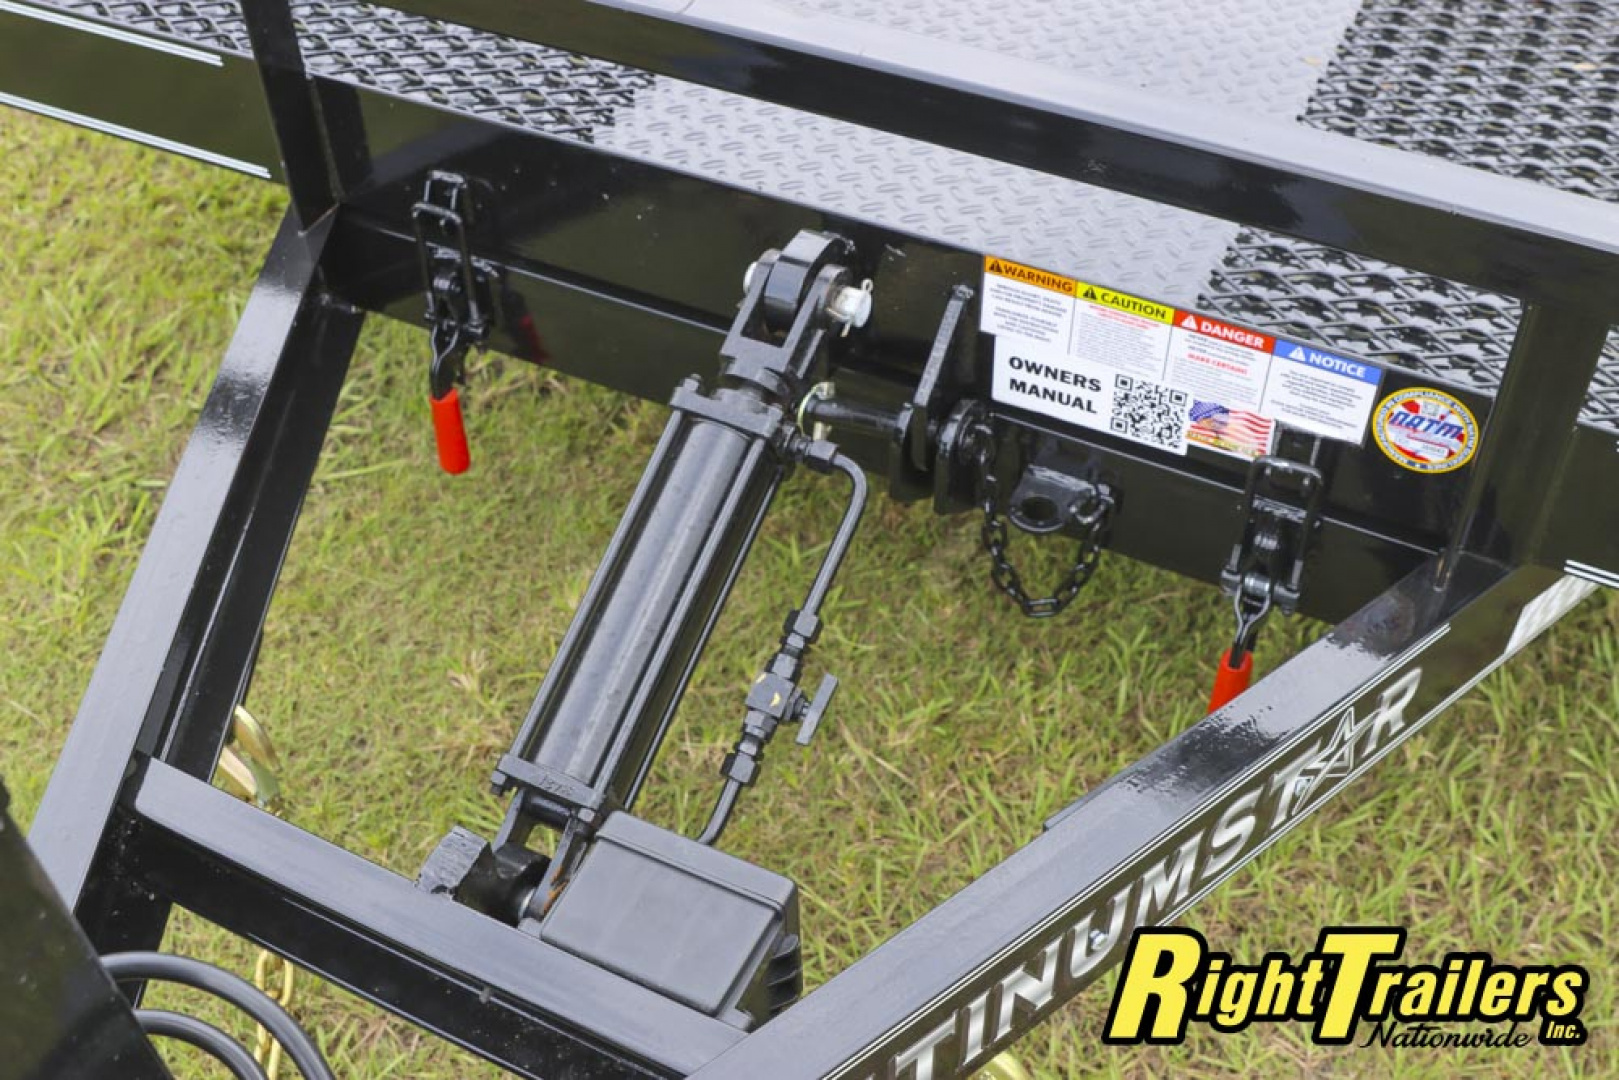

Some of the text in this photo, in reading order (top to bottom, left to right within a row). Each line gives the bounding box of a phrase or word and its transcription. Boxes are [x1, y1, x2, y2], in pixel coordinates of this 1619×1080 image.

[1004, 263, 1073, 292] WARNING
[1101, 291, 1166, 319] CAUTION
[1201, 320, 1264, 348] DANGER
[1009, 356, 1101, 392] OWNERS
[1310, 353, 1366, 378] NOTICE
[1009, 378, 1097, 414] MANUAL
[865, 667, 1422, 1080] TINUMSTAR
